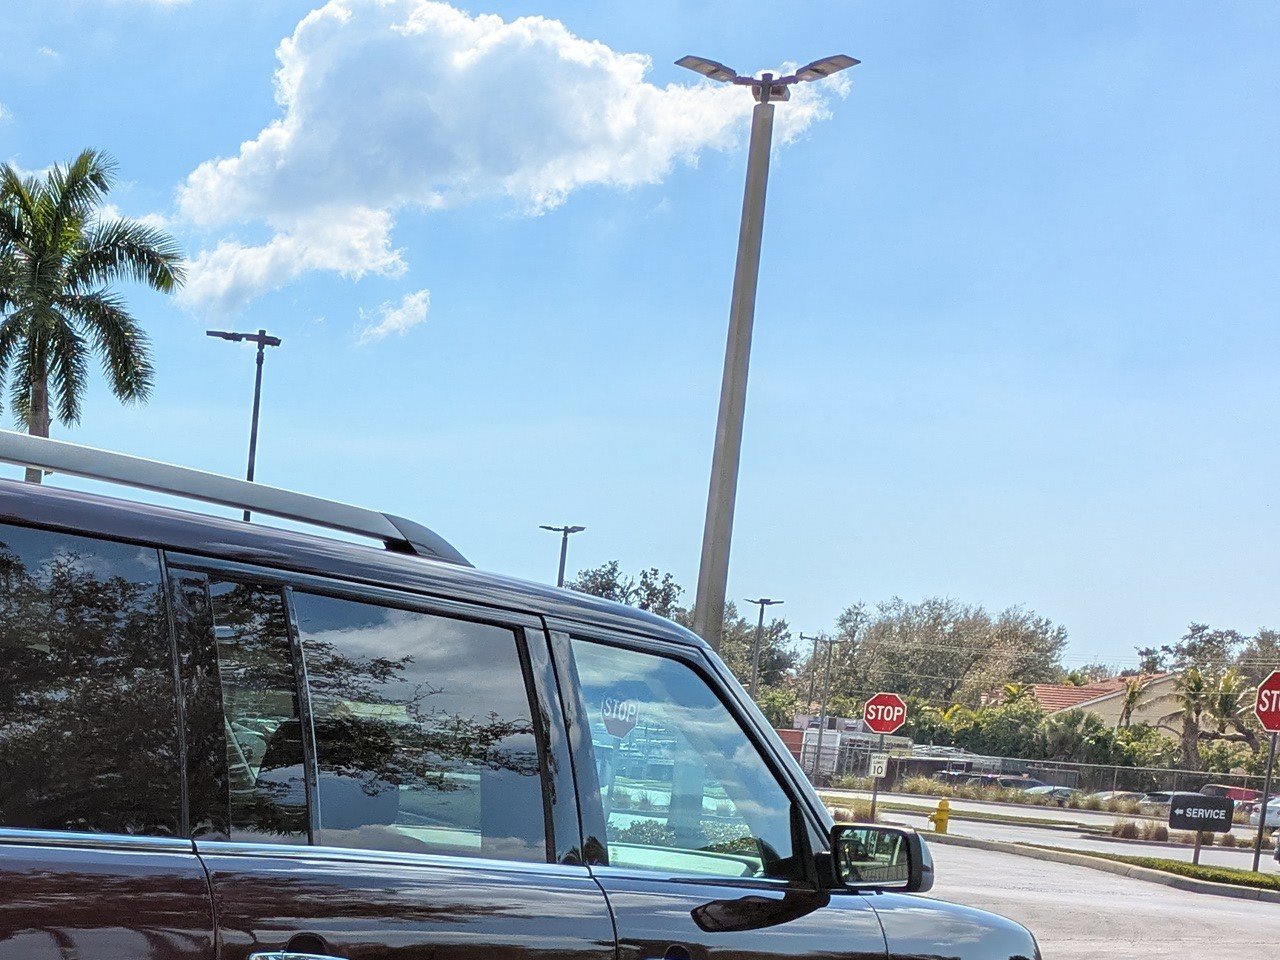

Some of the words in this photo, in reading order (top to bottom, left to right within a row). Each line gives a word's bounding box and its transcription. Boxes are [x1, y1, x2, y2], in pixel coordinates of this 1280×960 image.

[1259, 689, 1280, 712] ST
[603, 697, 637, 722] STOP
[867, 705, 903, 721] STOP
[872, 765, 883, 775] 10
[1185, 807, 1227, 820] SERVICE
